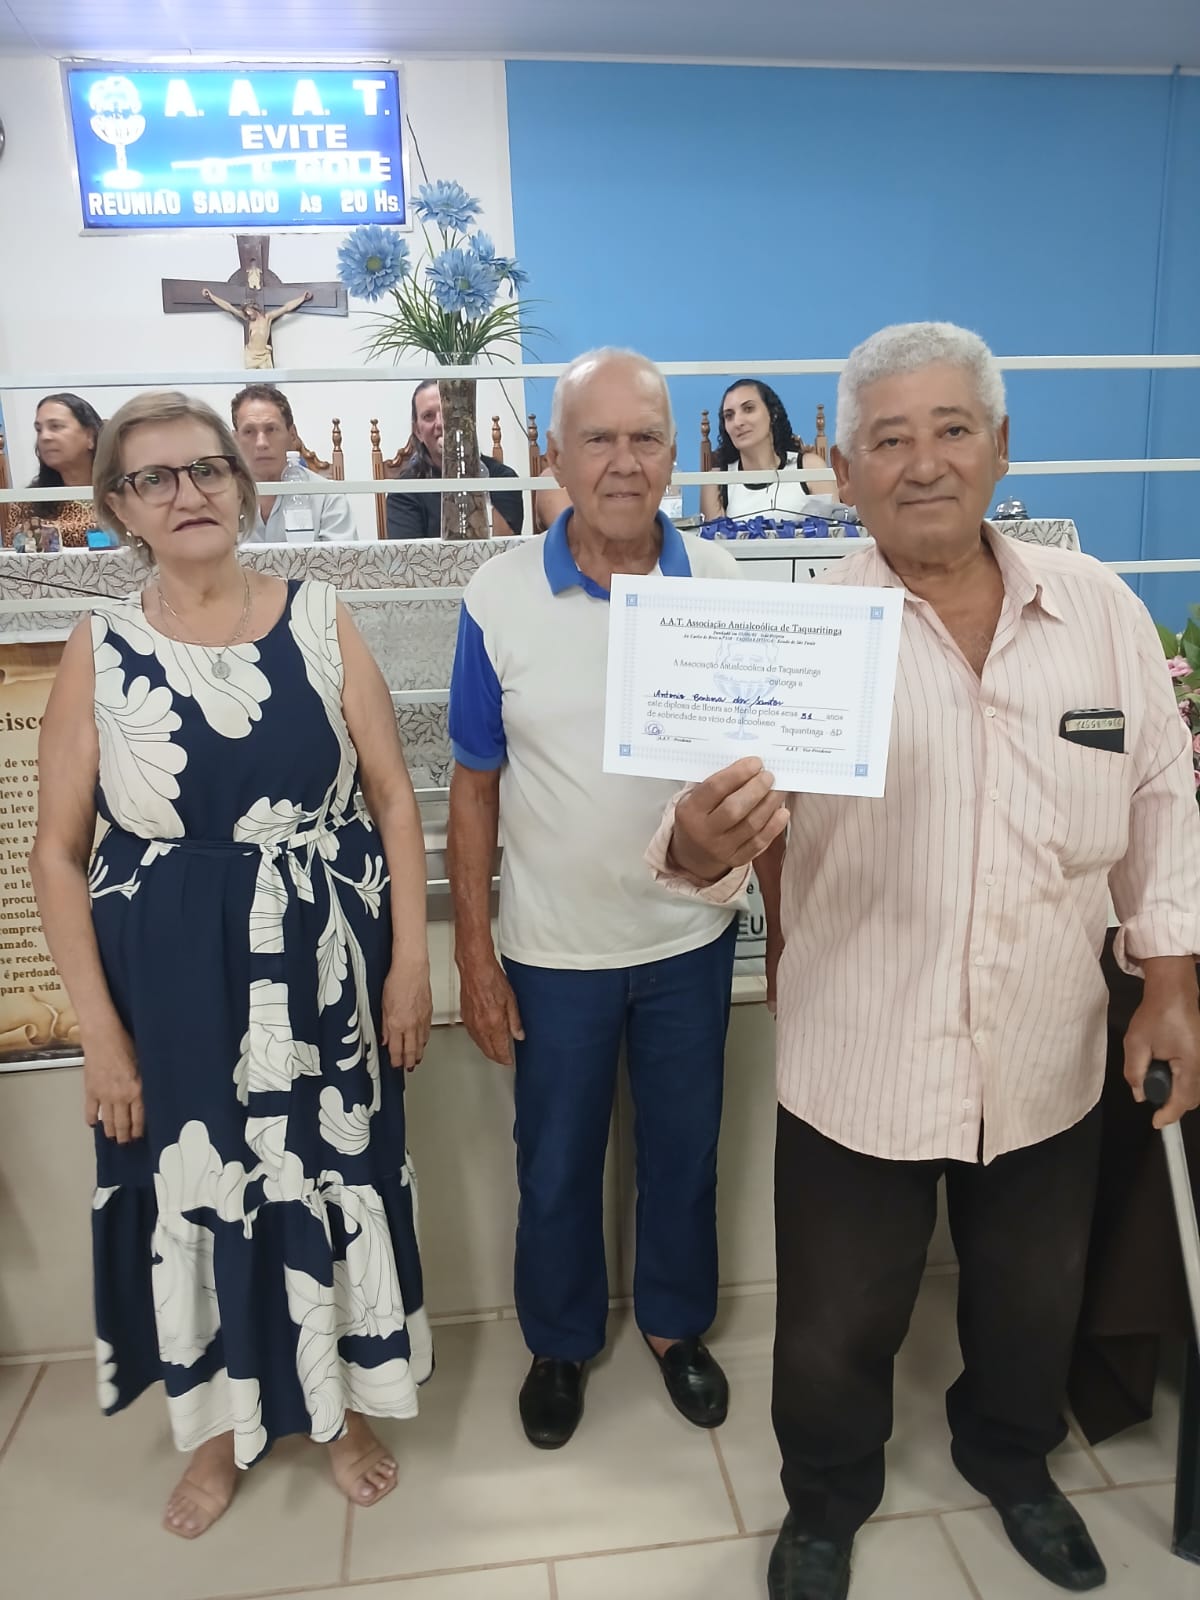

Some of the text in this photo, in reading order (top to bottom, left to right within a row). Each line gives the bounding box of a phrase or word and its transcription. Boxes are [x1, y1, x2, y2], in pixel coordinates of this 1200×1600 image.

[164, 79, 390, 117] A. A. A. T.
[240, 124, 348, 149] EVITE
[88, 189, 180, 215] REUNIÃO
[340, 191, 367, 213] 20
[686, 618, 726, 630] Associação
[728, 620, 777, 632] Antialcoólica
[780, 624, 790, 633] de
[791, 623, 842, 636] Taquaritinga
[680, 659, 718, 670] Associação
[767, 664, 777, 673] de
[691, 702, 701, 710] de
[4, 758, 17, 768] de
[22, 775, 29, 783] o
[11, 804, 34, 814] leve
[0, 821, 14, 830] eu
[7, 850, 31, 859] leve
[4, 881, 18, 890] eu
[0, 925, 43, 936] ompree
[0, 981, 61, 997] para a vida
